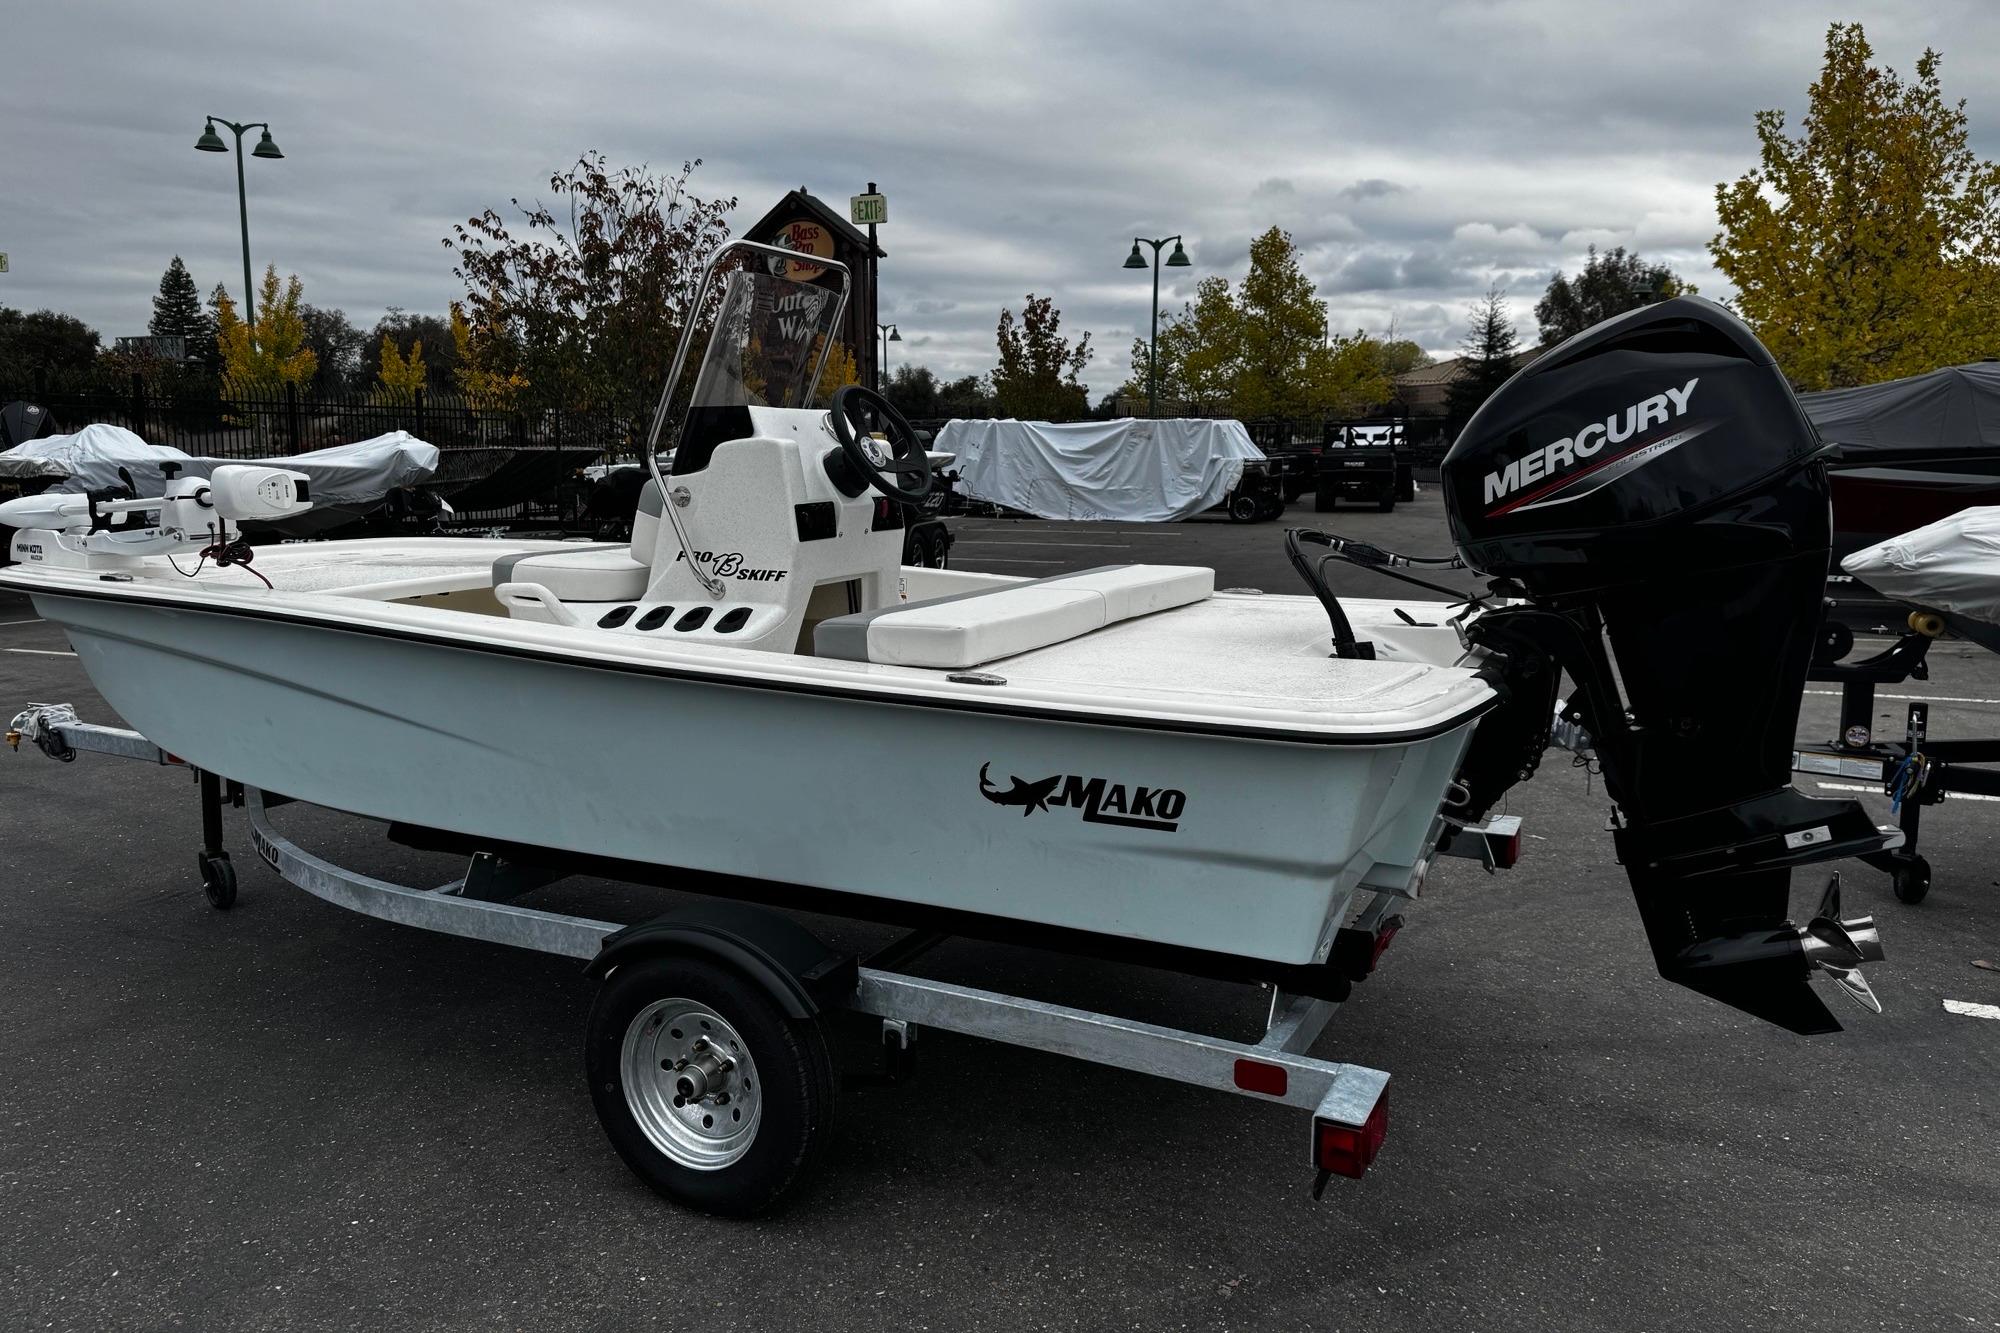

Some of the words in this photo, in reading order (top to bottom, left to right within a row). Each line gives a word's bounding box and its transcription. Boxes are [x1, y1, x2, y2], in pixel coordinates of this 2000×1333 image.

[857, 200, 879, 220] EXIT
[792, 224, 820, 240] Bass
[794, 241, 814, 254] Pro
[1484, 377, 1700, 505] MERCURY
[30, 544, 43, 554] KOTA
[736, 568, 788, 582] SKIFF
[1048, 775, 1187, 832] MAKO
